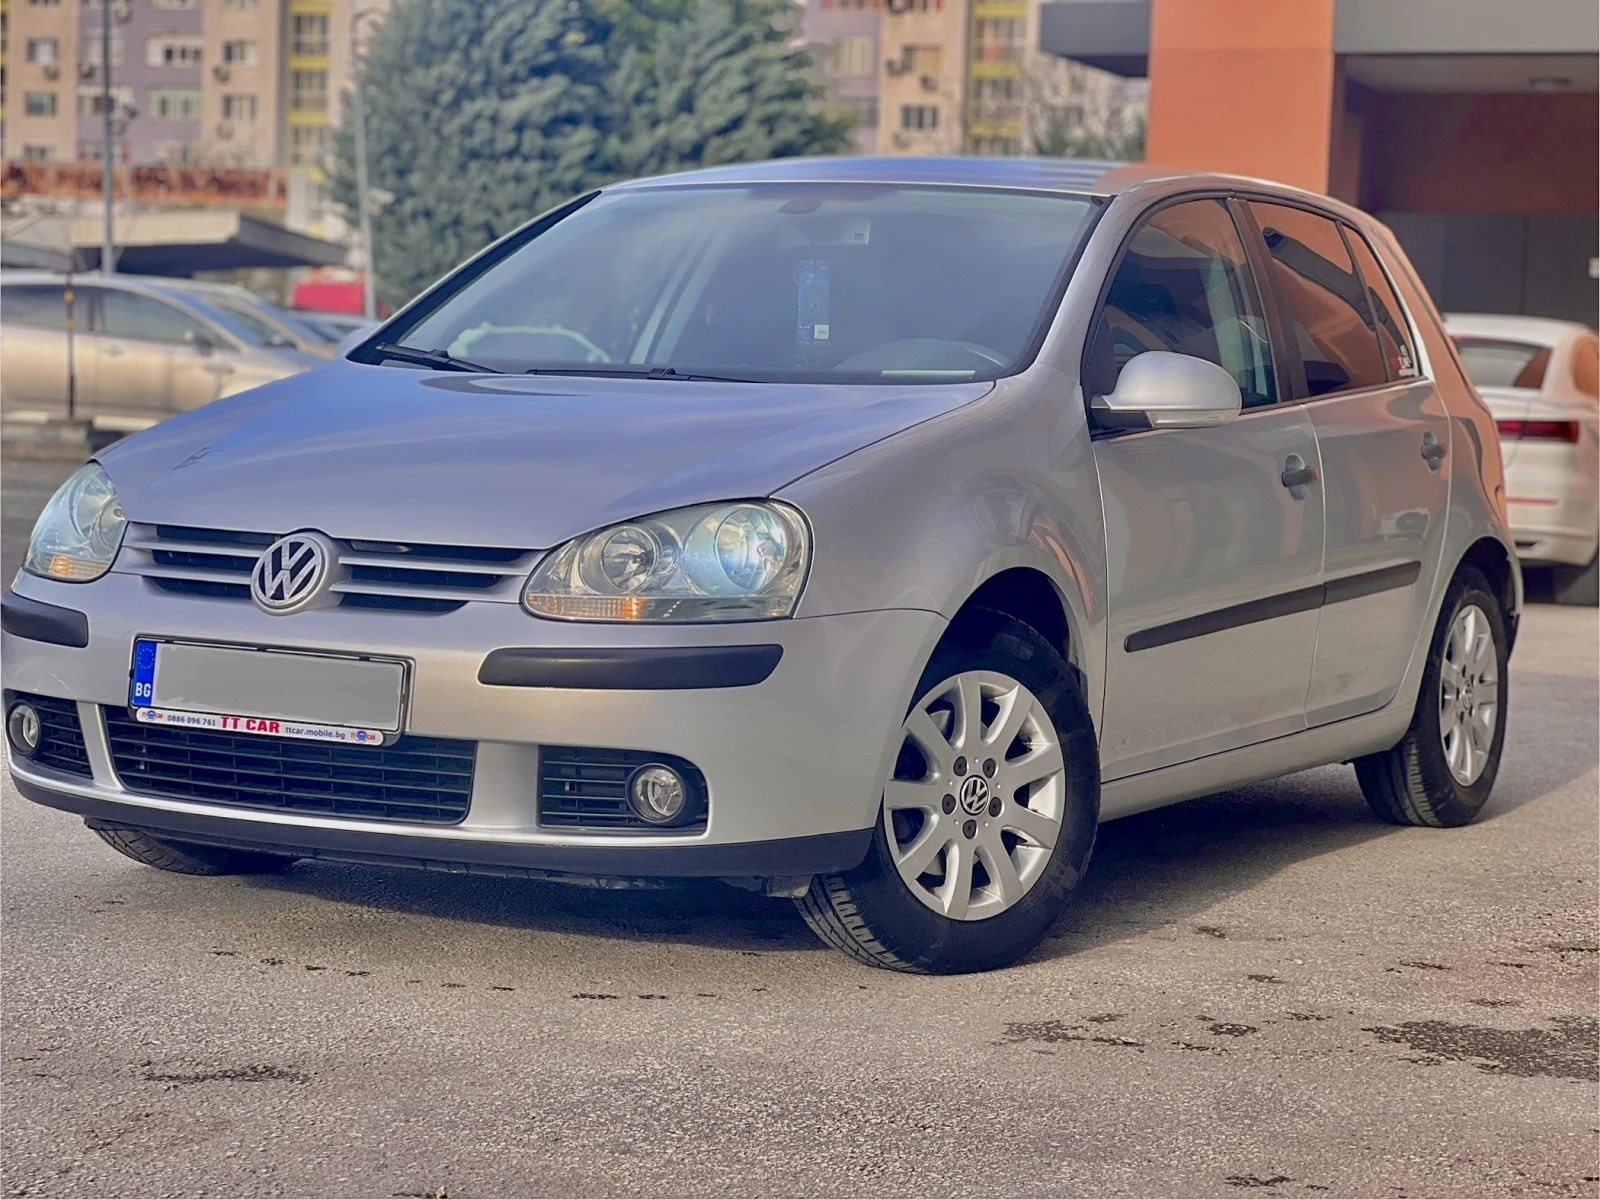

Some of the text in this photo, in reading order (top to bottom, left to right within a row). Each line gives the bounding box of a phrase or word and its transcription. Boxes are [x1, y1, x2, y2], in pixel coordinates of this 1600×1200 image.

[135, 682, 152, 698] BG
[167, 714, 216, 726] 0886 096 761
[221, 716, 280, 733] TT CAR
[285, 726, 346, 740] ttcar.mobile.bg
